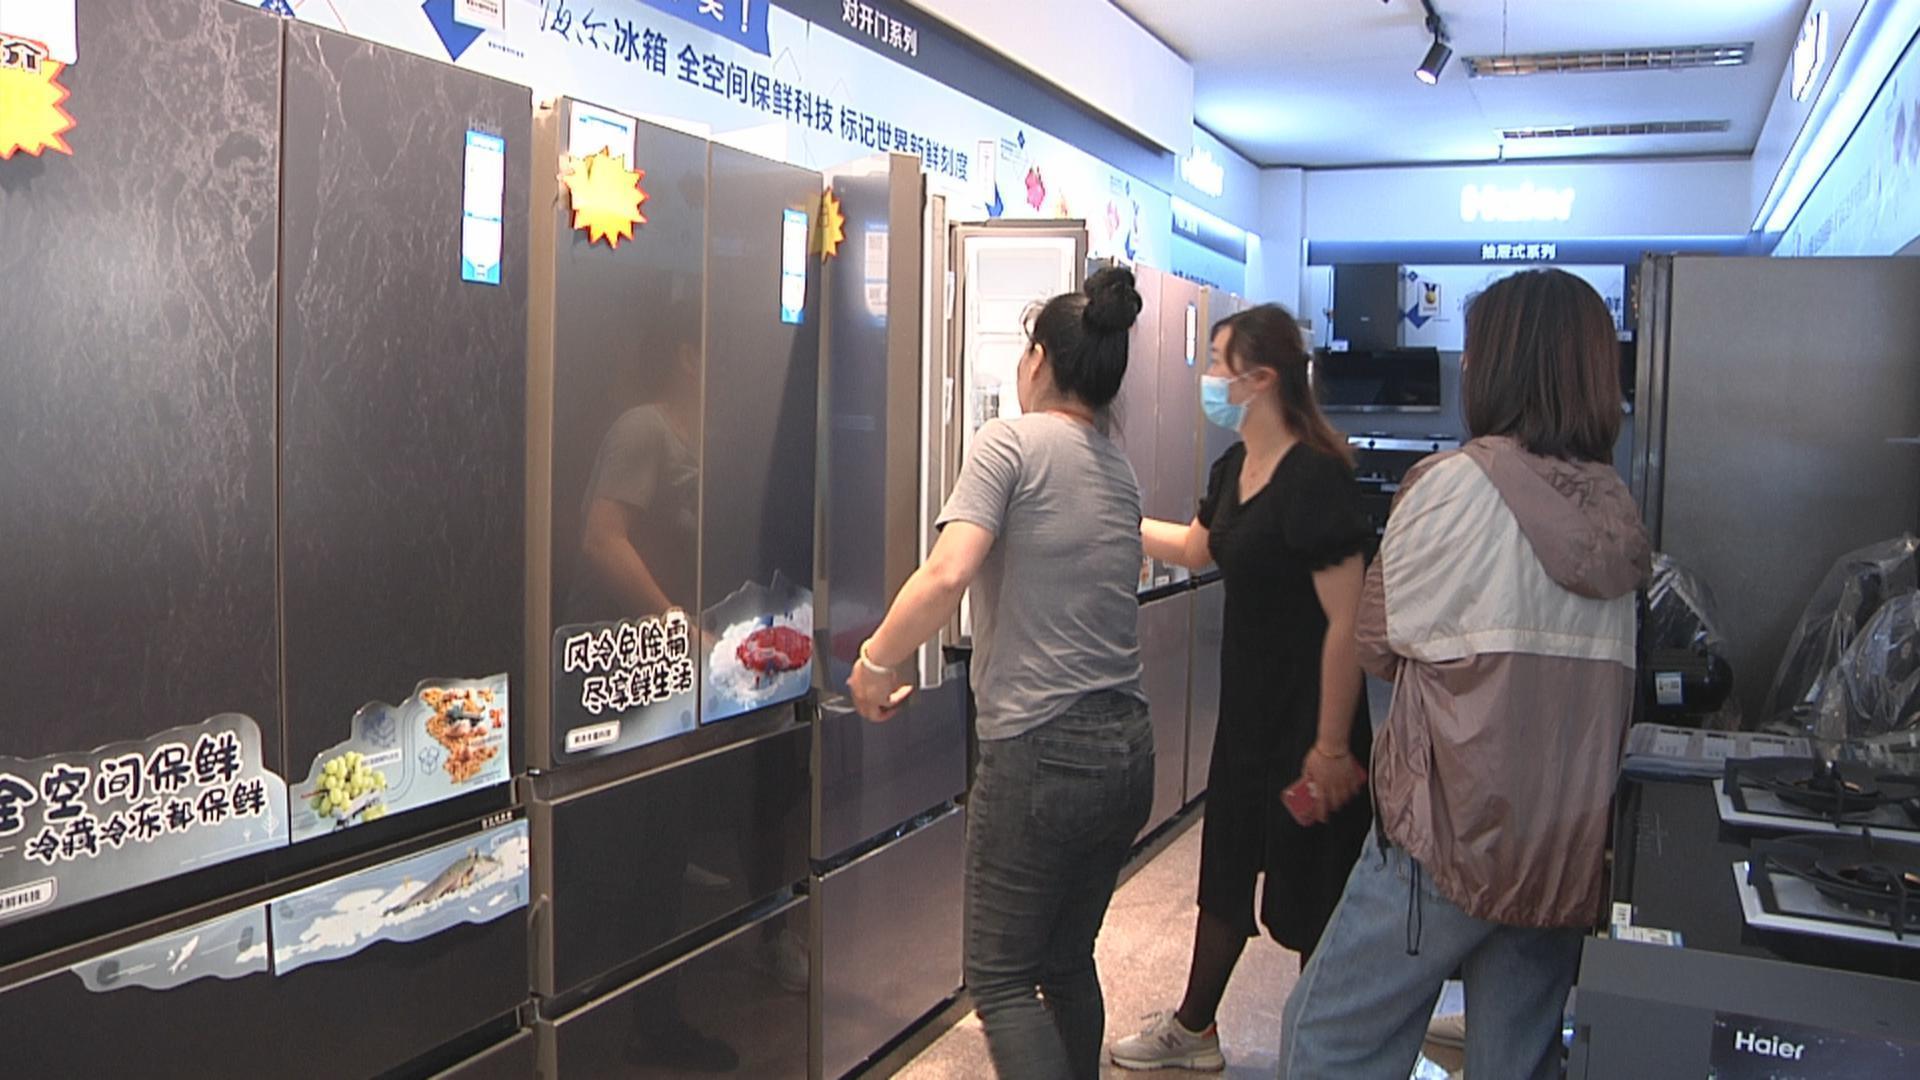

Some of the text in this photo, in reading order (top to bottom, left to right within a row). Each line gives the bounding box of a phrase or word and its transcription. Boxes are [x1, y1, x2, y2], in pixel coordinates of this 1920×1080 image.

[842, 0, 917, 57] 对开门系列
[677, 44, 833, 134] 全空间保鲜科技
[840, 105, 968, 181] 标记世界新鲜刻度
[565, 616, 687, 671] 风冷免除霜
[583, 661, 692, 712] 尽享鲜生活
[0, 732, 241, 834] 全空间保鲜
[27, 778, 267, 862] 冷藏冷冻都保鲜
[1735, 1030, 1805, 1060] Haier
